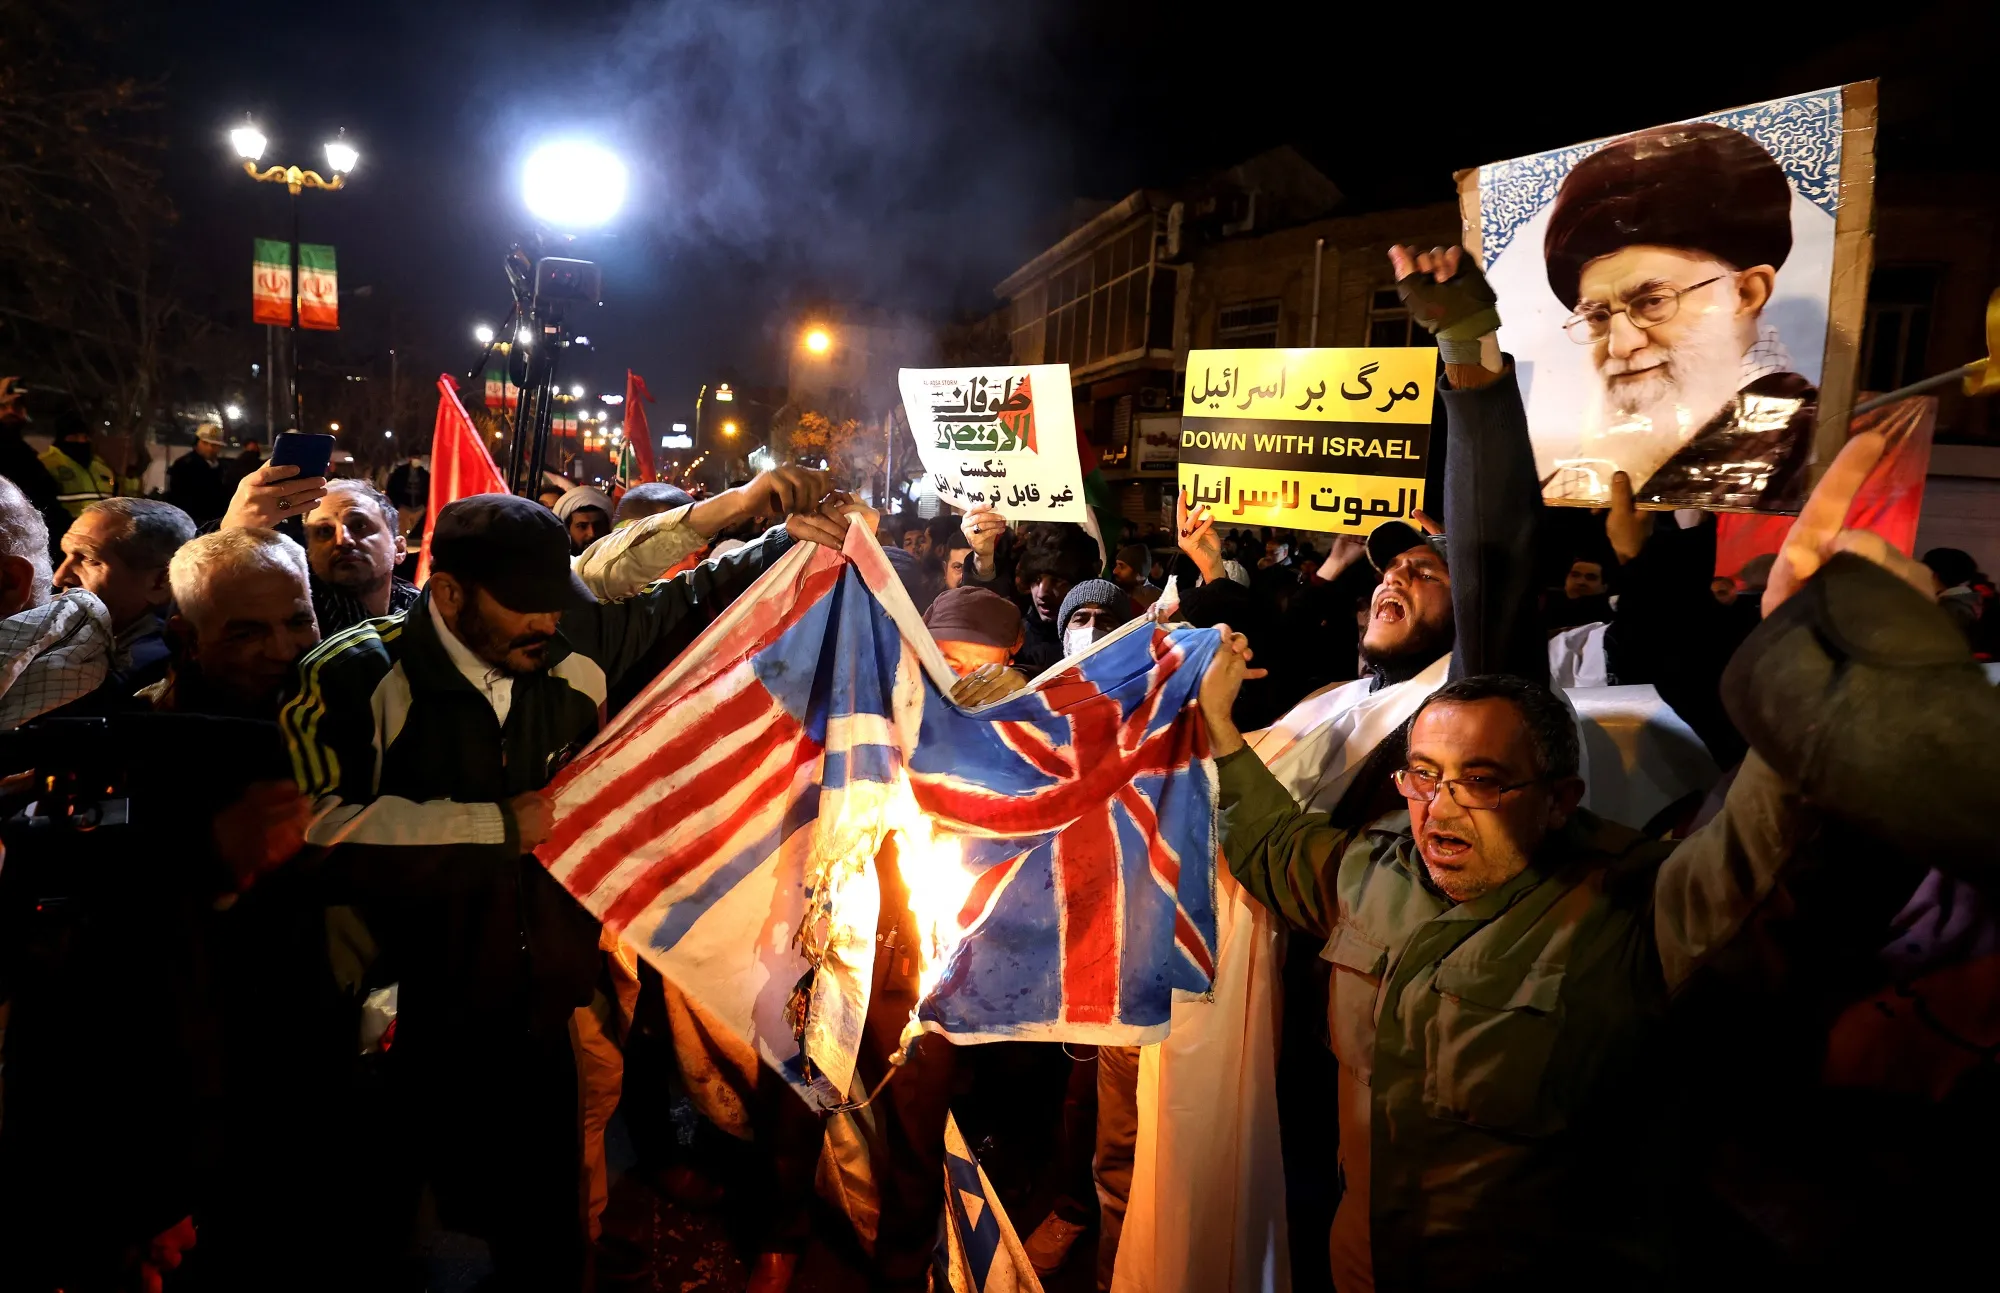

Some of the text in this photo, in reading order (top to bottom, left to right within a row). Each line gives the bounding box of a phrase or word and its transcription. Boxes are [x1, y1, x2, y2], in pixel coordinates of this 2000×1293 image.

[1190, 361, 1420, 413] مرگ بر اسرائیل
[1181, 430, 1247, 451] DOWN
[1253, 434, 1314, 455] WITH
[1322, 437, 1421, 460] ISRAEL
[960, 459, 1007, 478] شکست
[1007, 483, 1041, 507] قابل
[1048, 485, 1074, 508] غیر
[1310, 487, 1418, 526] الموت
